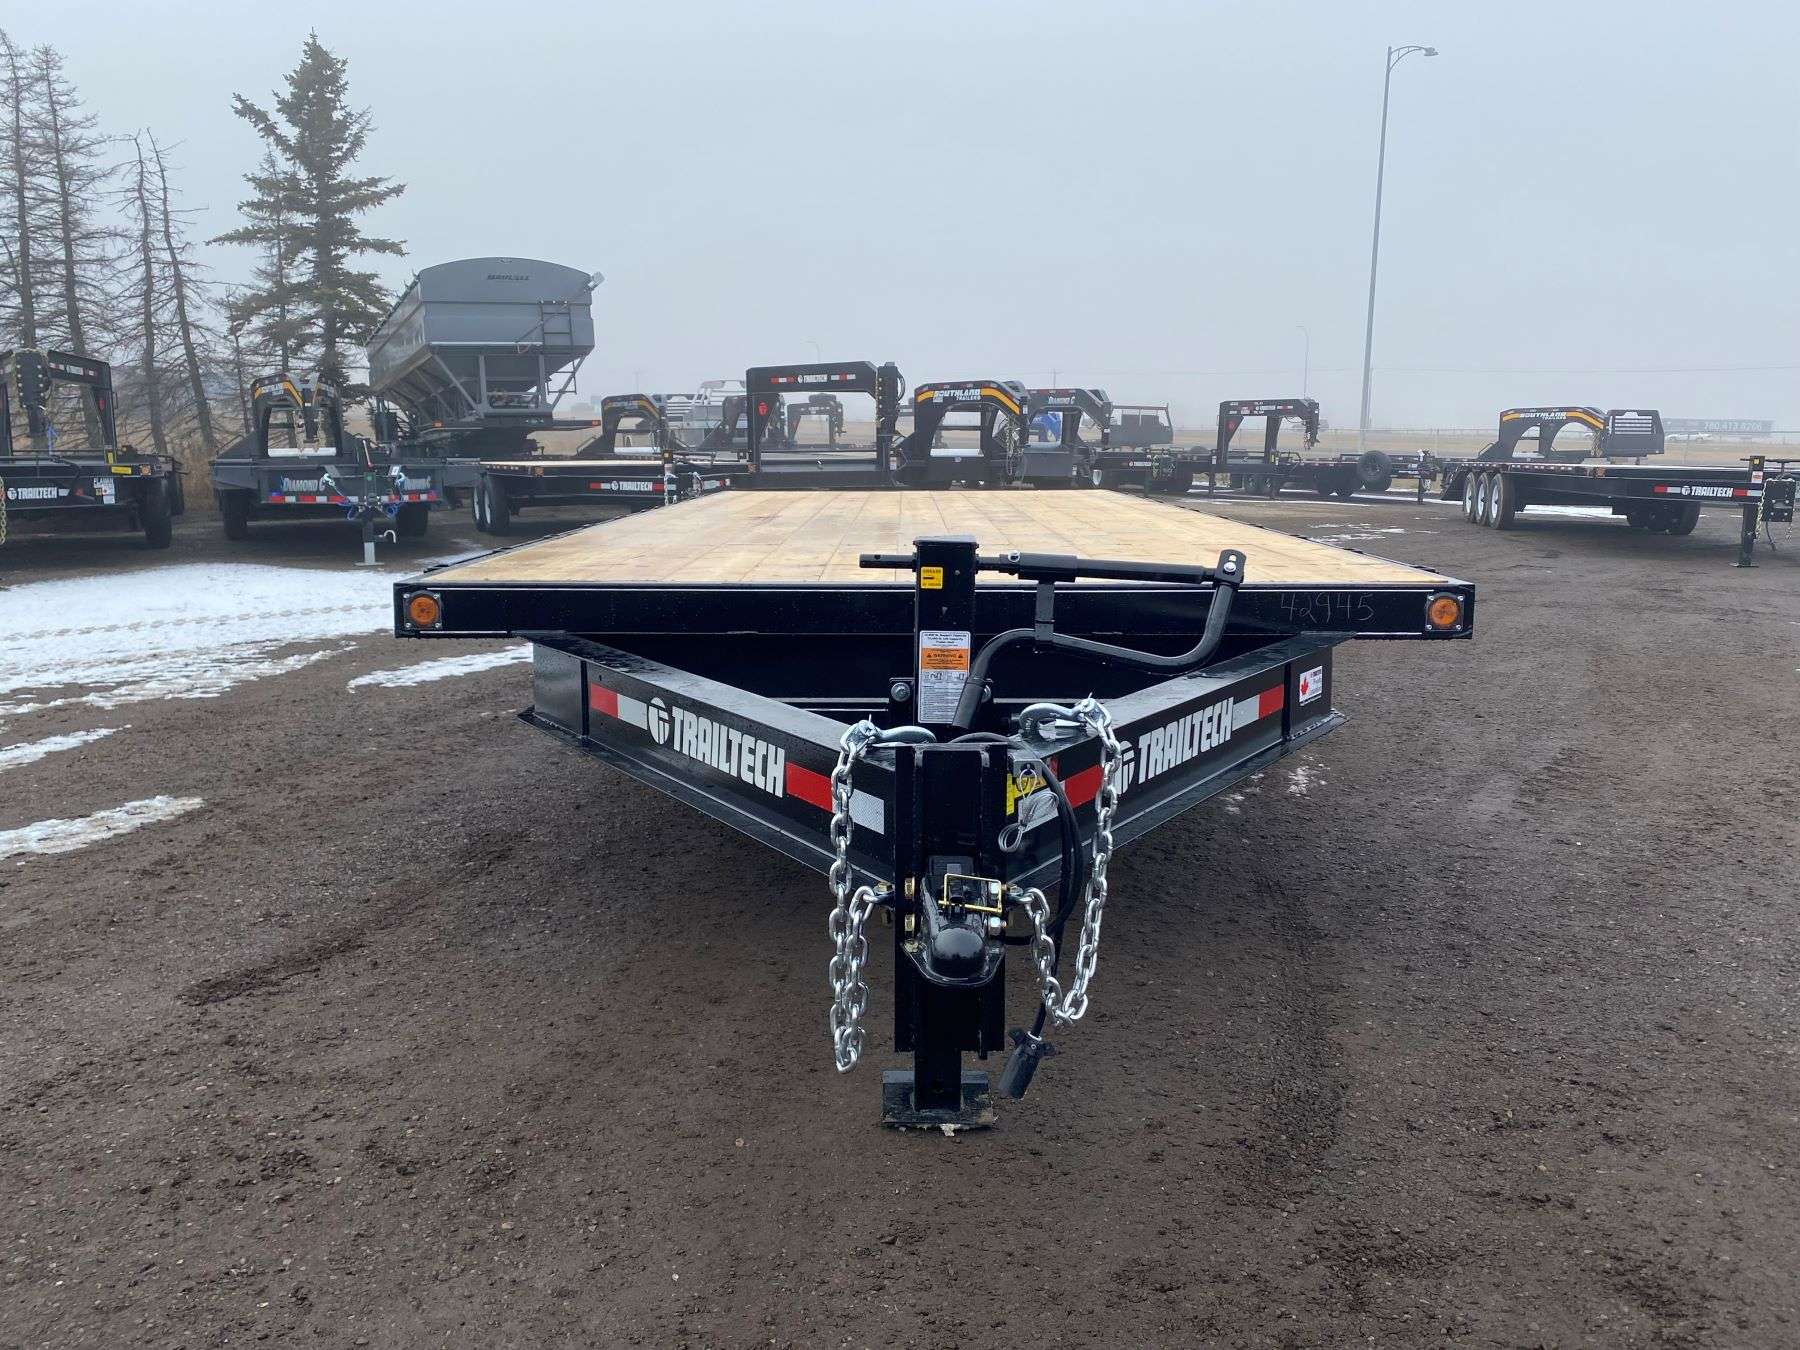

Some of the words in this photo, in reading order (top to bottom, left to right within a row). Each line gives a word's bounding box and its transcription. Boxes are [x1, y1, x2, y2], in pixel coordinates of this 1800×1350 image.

[934, 389, 981, 398] SOUTHLAND
[283, 477, 318, 491] DIAMOND
[619, 481, 653, 491] TRAILTECH
[17, 487, 58, 499] TRAILTECH
[1691, 486, 1734, 498] TRAILTECH
[1280, 591, 1375, 624] 42945
[1138, 697, 1234, 784] TRAILTECH
[671, 706, 785, 798] TRAILTECH
